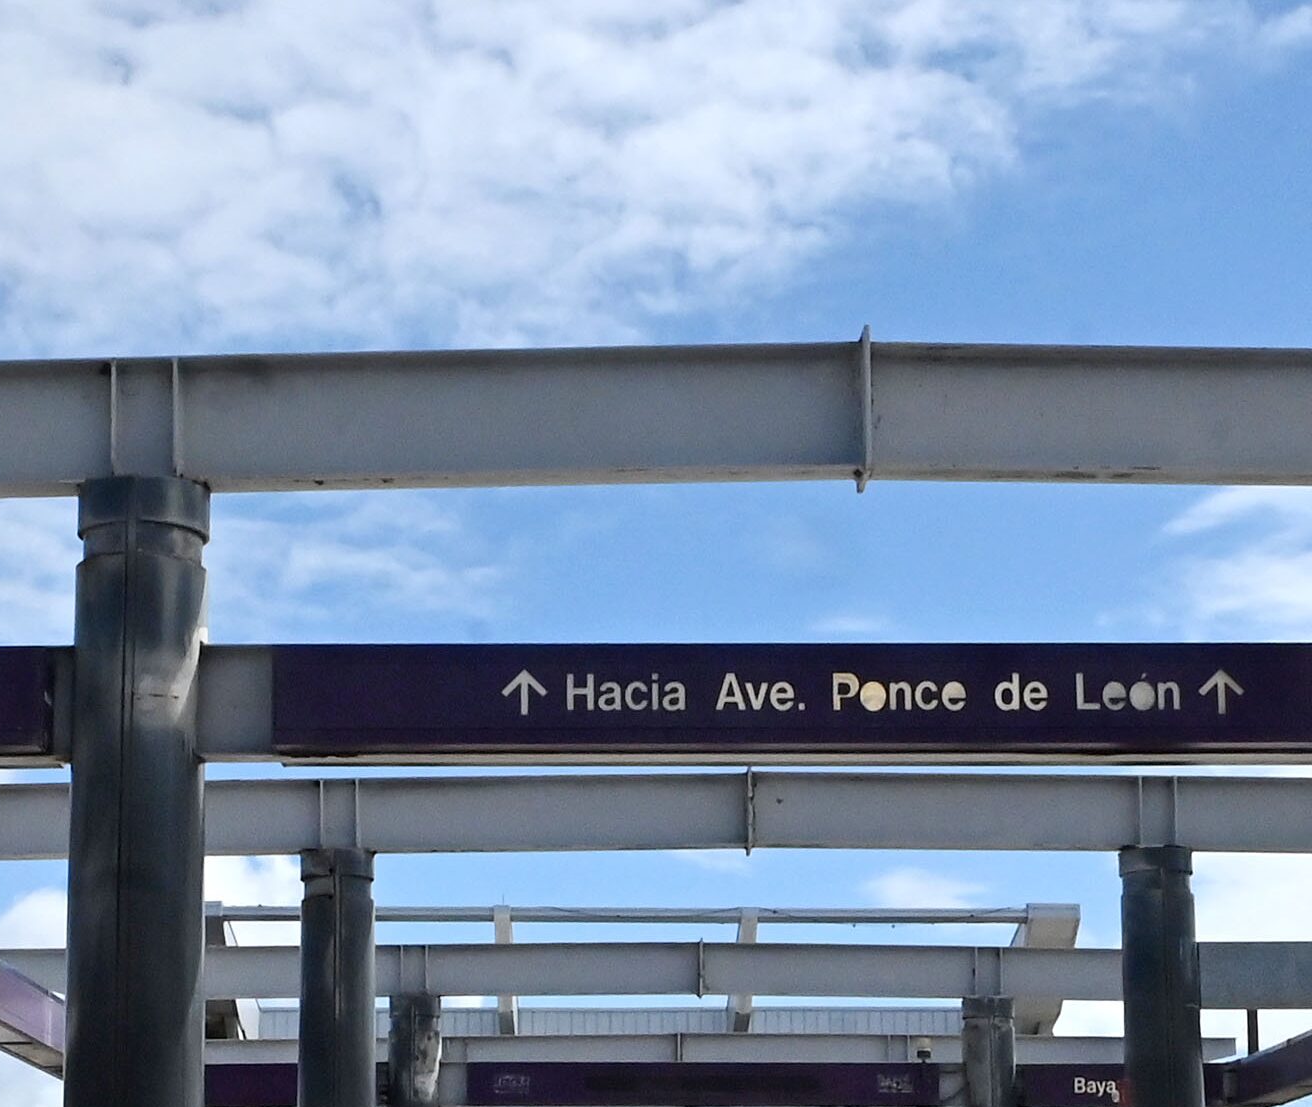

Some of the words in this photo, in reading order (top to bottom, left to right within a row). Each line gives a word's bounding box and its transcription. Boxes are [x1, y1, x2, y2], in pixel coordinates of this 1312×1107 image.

[566, 672, 686, 712] Hacia
[715, 672, 806, 712] Ave.
[832, 672, 967, 712] Ponce
[994, 672, 1048, 712] de
[1075, 672, 1181, 712] León
